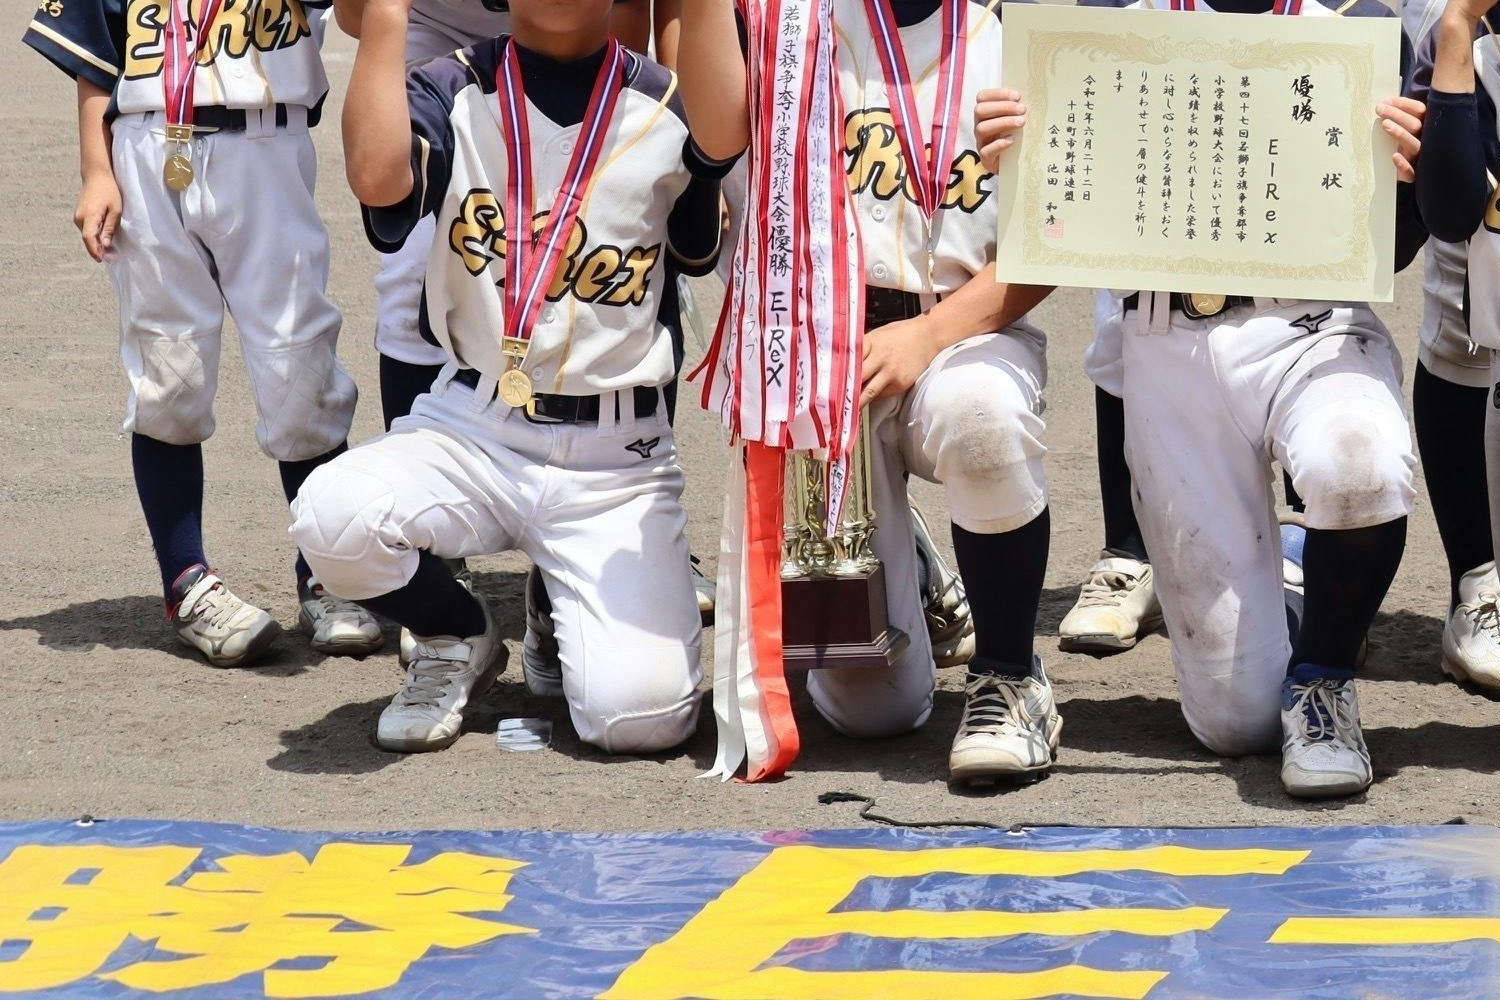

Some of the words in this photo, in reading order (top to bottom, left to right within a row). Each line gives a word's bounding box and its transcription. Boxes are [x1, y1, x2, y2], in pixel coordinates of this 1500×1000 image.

[1082, 74, 1097, 202] 令和七年六月二十二日
[1113, 69, 1125, 93] ます
[1290, 74, 1317, 125] 優勝
[1064, 99, 1078, 202] 十日町市野球連盟
[1185, 73, 1201, 240] な成績を収められました栄誉
[1210, 75, 1226, 242] 小学校野球大会において優秀
